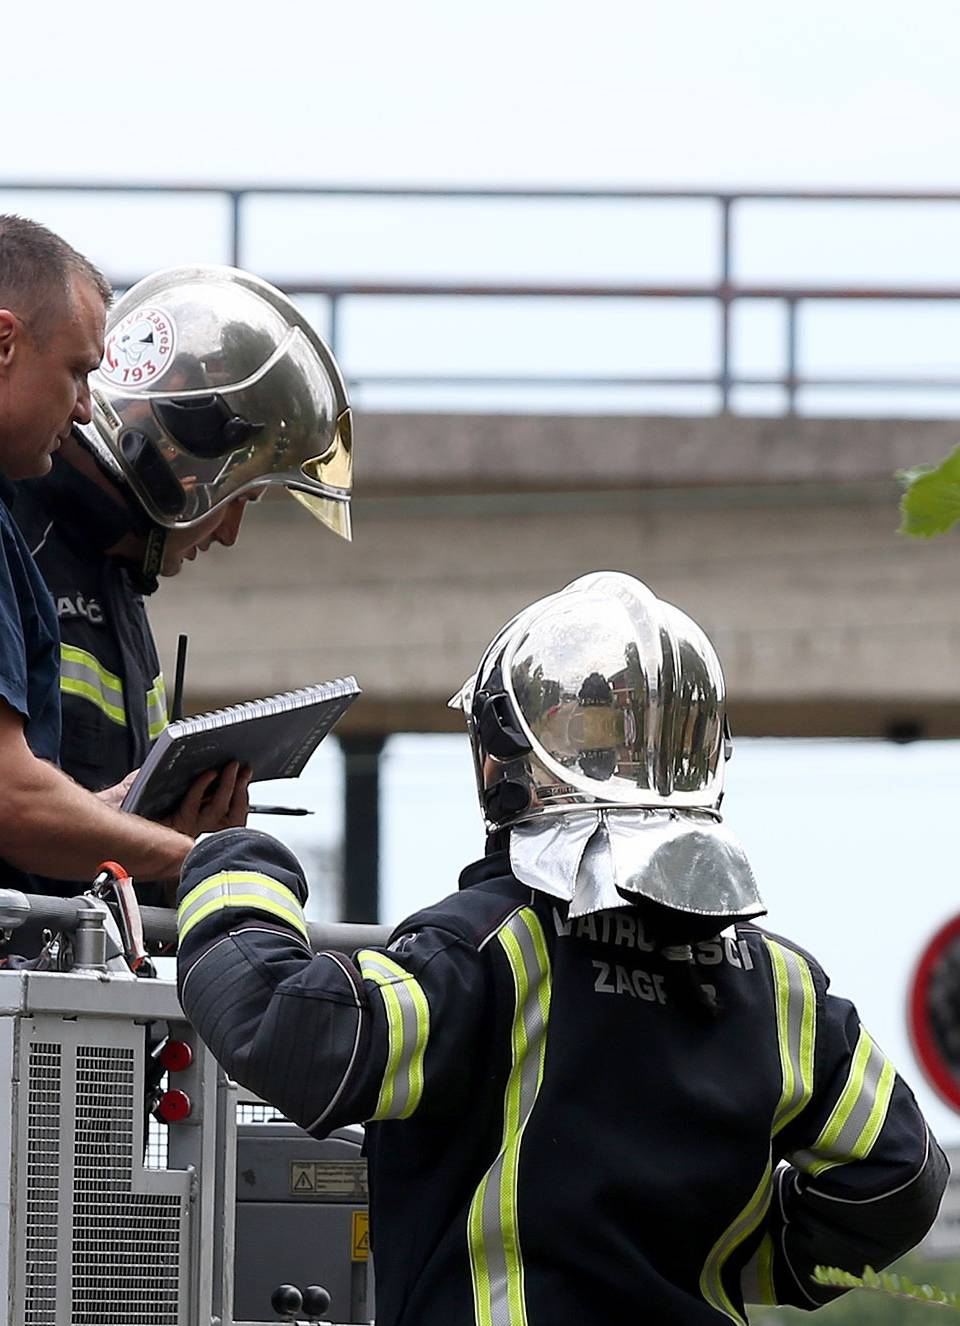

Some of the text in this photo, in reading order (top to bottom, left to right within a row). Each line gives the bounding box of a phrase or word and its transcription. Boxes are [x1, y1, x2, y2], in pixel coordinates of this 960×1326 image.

[146, 311, 170, 355] Zagreb
[122, 359, 157, 382] 193
[551, 906, 755, 971] VATROSCI
